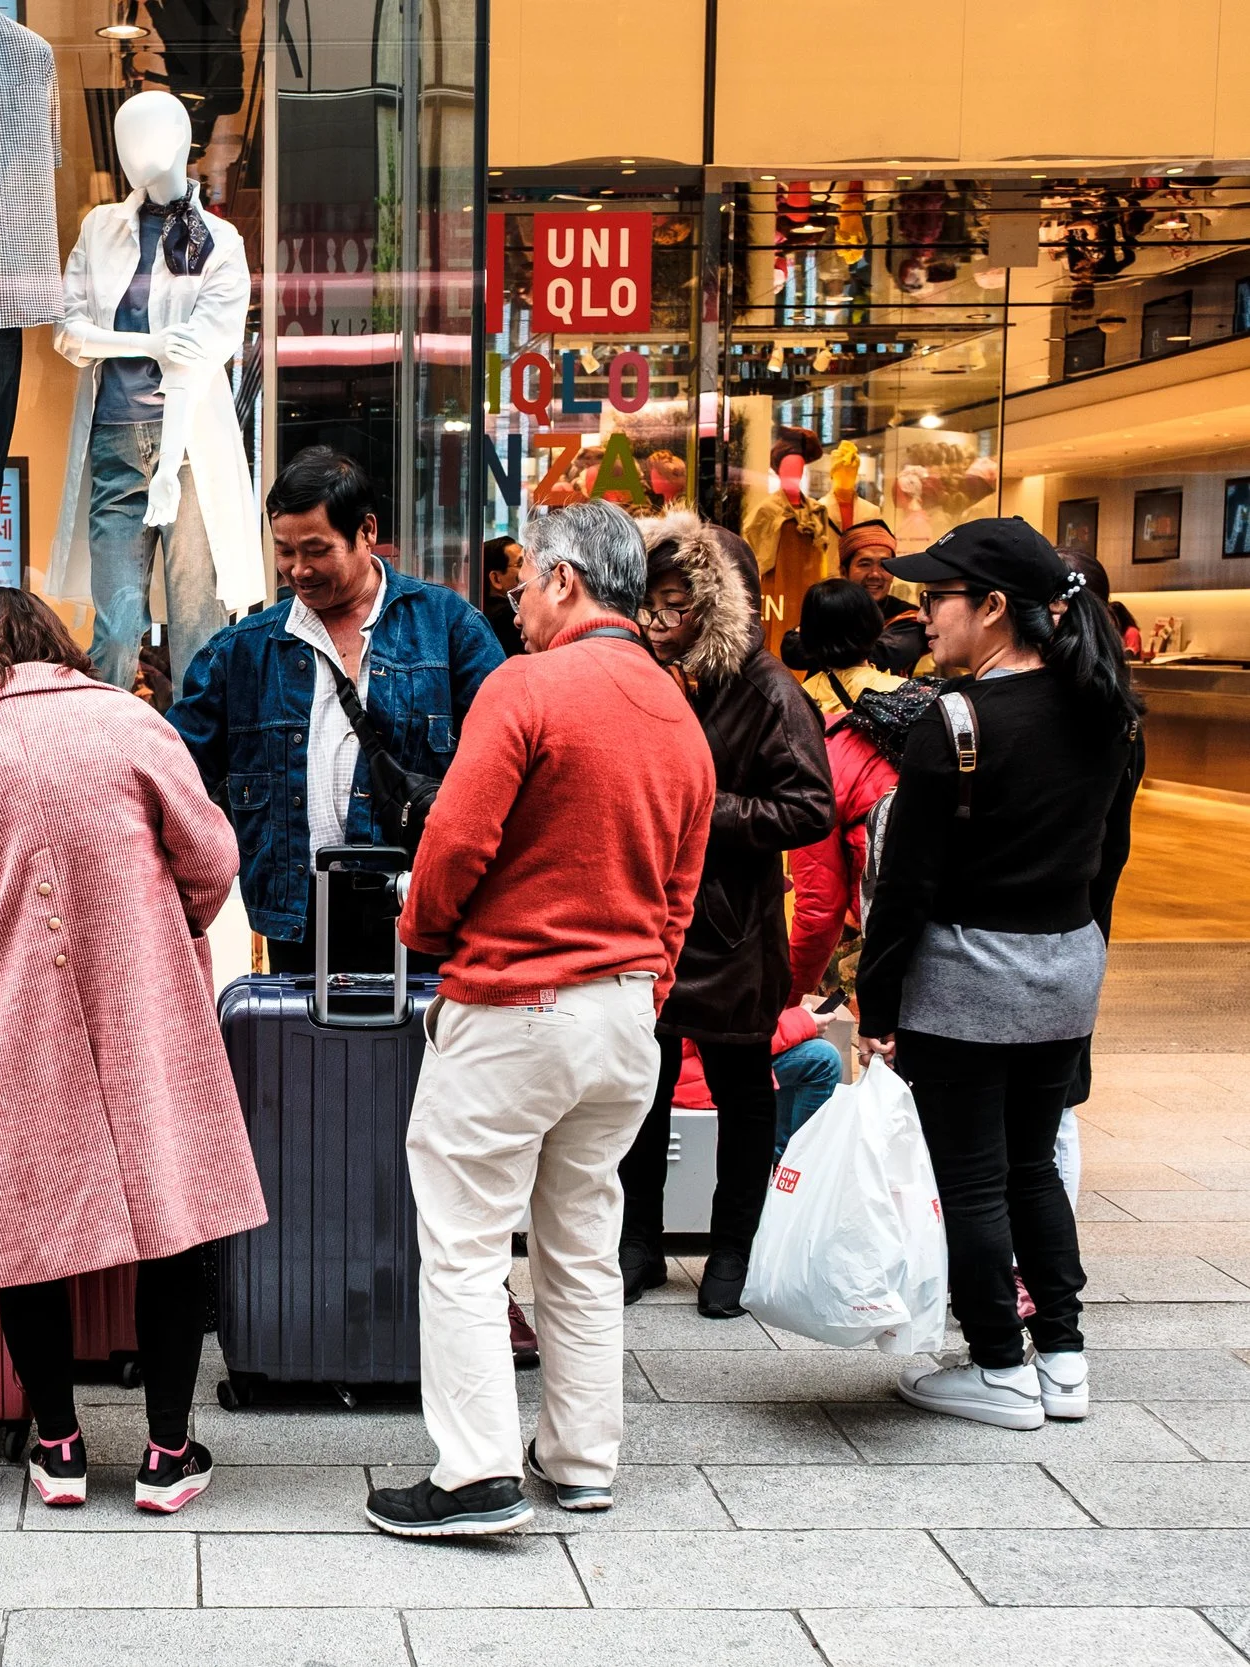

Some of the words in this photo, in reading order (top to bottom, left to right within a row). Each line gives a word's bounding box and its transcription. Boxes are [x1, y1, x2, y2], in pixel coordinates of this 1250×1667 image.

[547, 228, 630, 268] UNI
[546, 277, 638, 325] QLO
[761, 594, 785, 622] N
[779, 1179, 795, 1191] QLO
[782, 1170, 798, 1182] UNI
